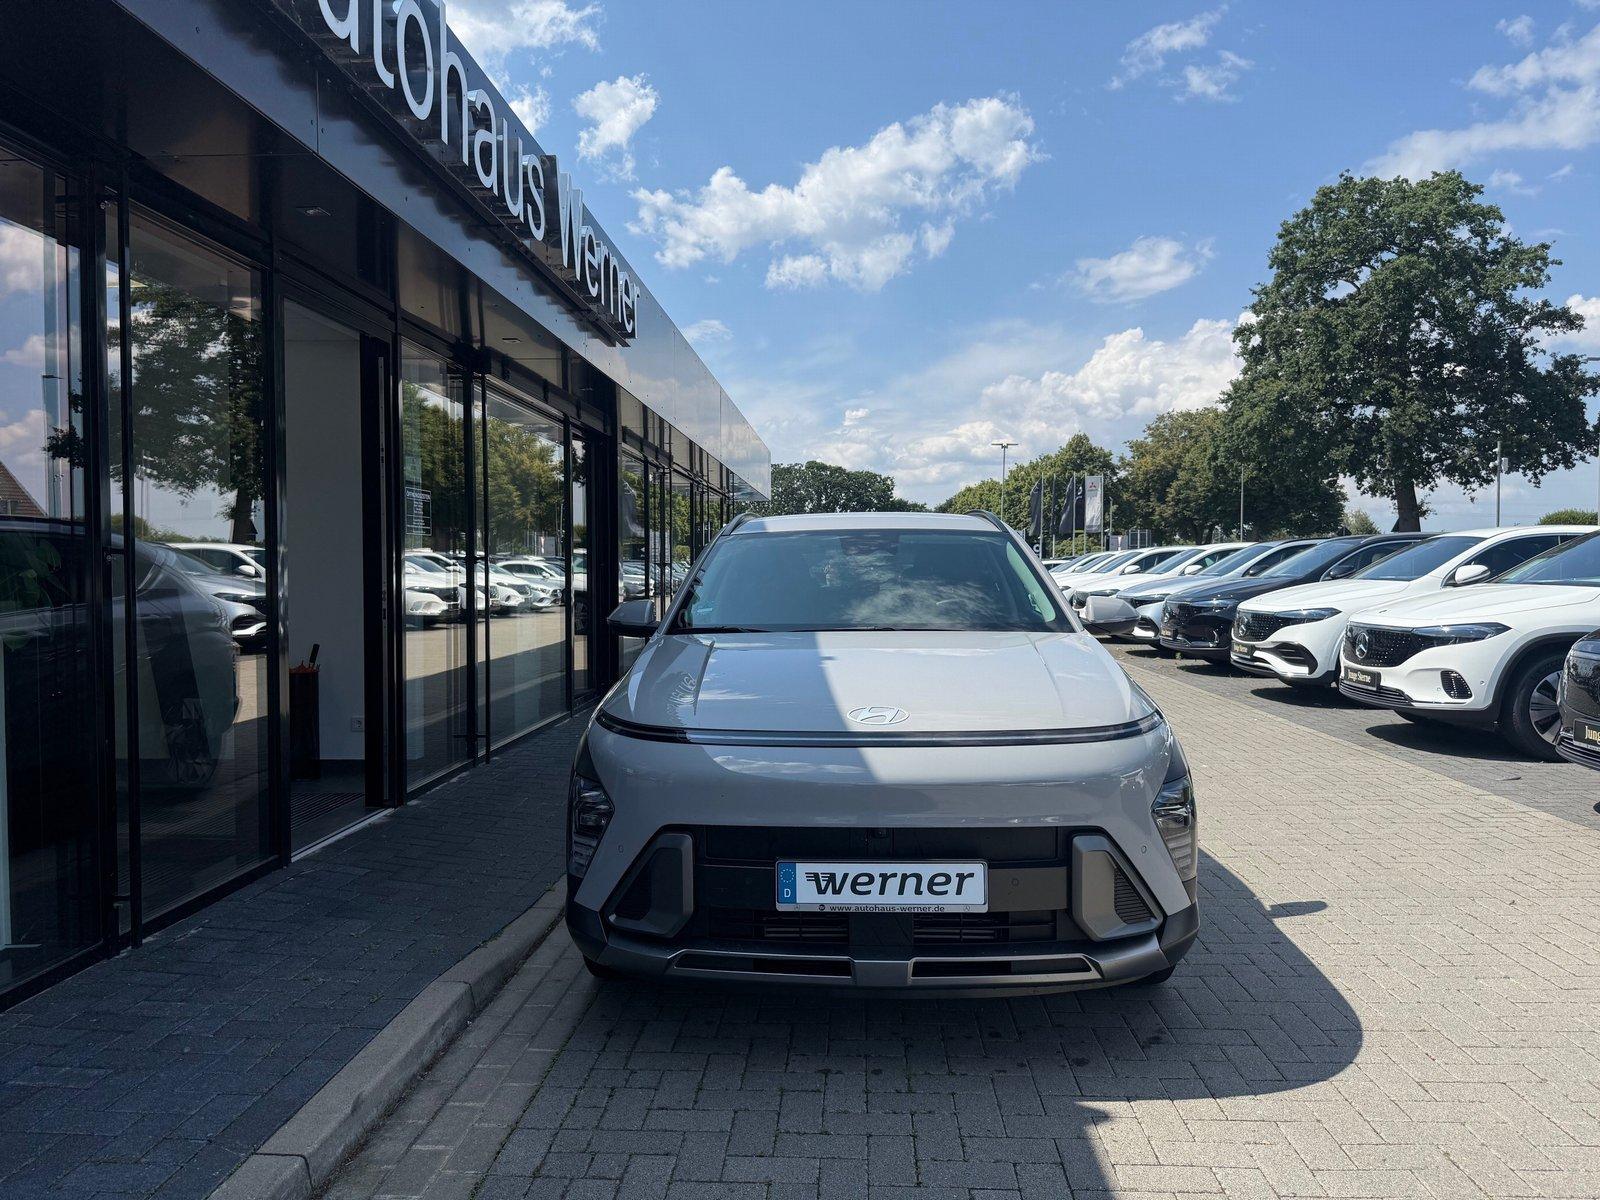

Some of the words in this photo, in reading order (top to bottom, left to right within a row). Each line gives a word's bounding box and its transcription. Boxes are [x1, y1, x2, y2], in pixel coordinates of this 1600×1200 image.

[551, 155, 641, 339] Werner
[805, 871, 974, 896] werner
[783, 888, 791, 898] D
[829, 904, 945, 913] www.autohaus-werner.de
